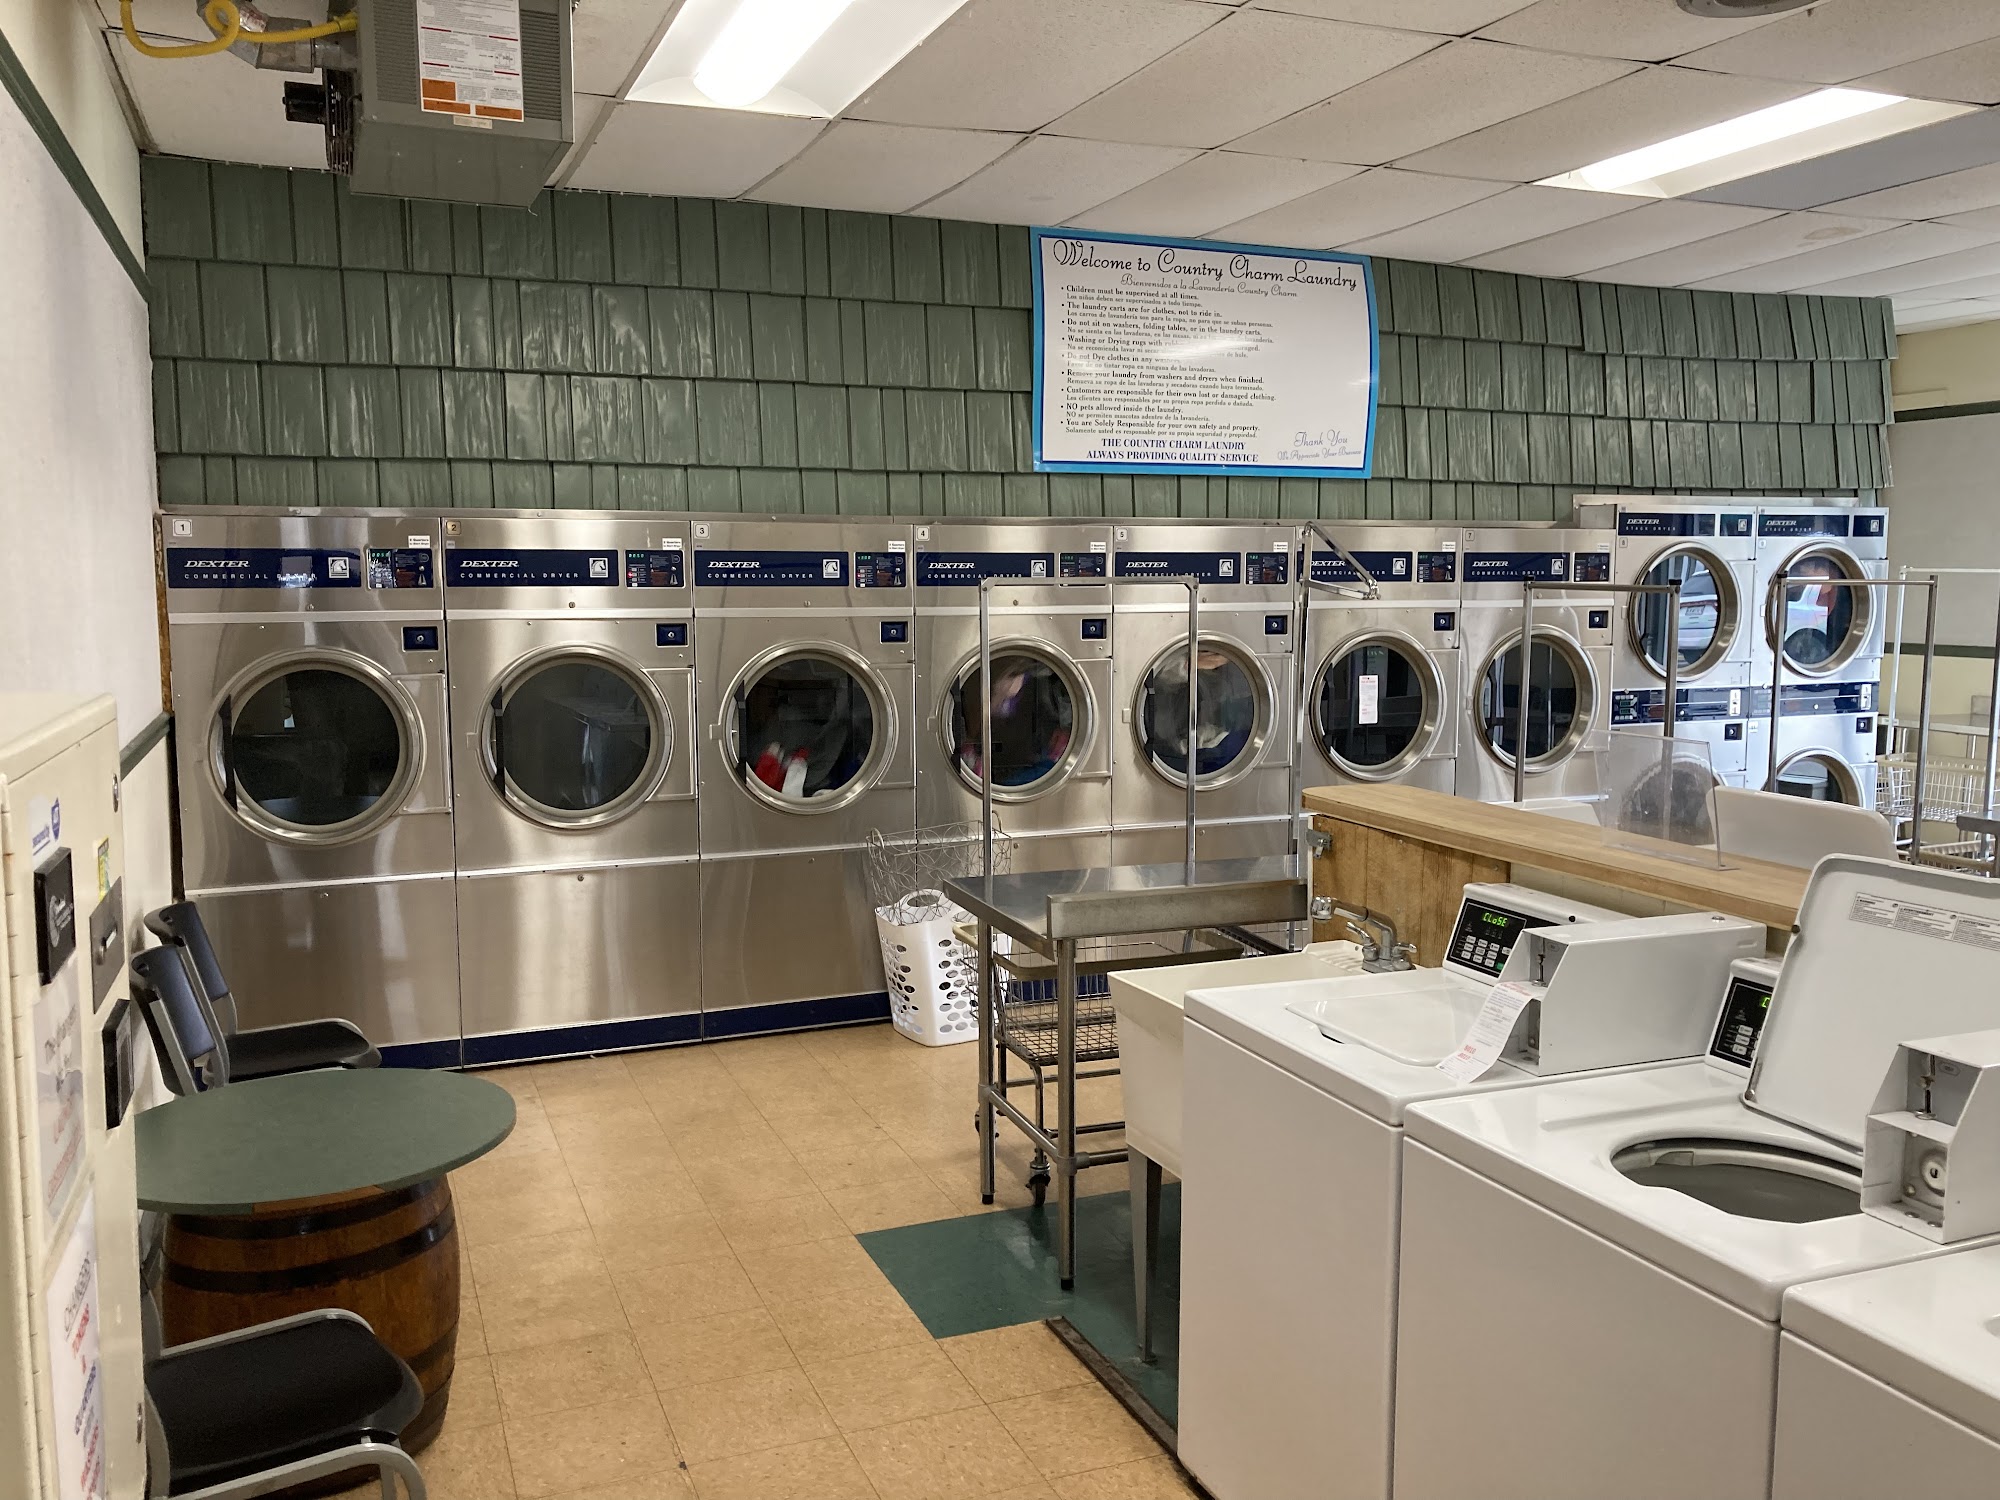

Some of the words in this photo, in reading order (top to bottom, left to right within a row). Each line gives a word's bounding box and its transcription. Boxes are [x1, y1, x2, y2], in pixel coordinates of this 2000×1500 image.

[1053, 240, 1132, 270] Welcome
[1138, 257, 1151, 272] to
[1158, 248, 1223, 281] Country
[1230, 254, 1284, 282] Charm
[1286, 260, 1357, 291] Laundry
[1066, 284, 1095, 293] Children
[1120, 273, 1171, 290] Bienvenidos
[1180, 279, 1187, 290] la
[1237, 282, 1269, 297] Country
[1271, 284, 1298, 298] Charm
[1082, 302, 1107, 311] laundry
[1152, 307, 1176, 315] clothes,
[1143, 322, 1165, 331] folding
[1220, 327, 1243, 335] laundry
[1068, 335, 1096, 344] Washing
[1108, 337, 1130, 345] Drying
[1092, 353, 1105, 361] Dye
[1112, 371, 1137, 379] laundry
[1157, 373, 1182, 382] washers
[1238, 376, 1264, 384] finished.
[1067, 386, 1101, 394] Customers
[1221, 392, 1248, 400] damaged
[1250, 393, 1276, 401] clothing.
[1096, 403, 1120, 411] allowed
[1157, 406, 1183, 414] laundry.
[1095, 419, 1114, 428] Solely
[1117, 420, 1155, 428] Responsible
[1294, 432, 1324, 447] Thank
[1327, 429, 1348, 446] You
[1101, 438, 1122, 447] THE
[1124, 439, 1167, 448] COUNTRY
[1169, 440, 1202, 449] CHARM
[1204, 441, 1246, 450] LAUNDRY
[1087, 451, 1125, 459] ALWAYS
[1127, 451, 1177, 461] PROVIDING
[1180, 452, 1218, 462] QUALITY
[1220, 454, 1258, 462] SERVICE
[180, 523, 185, 532] 1
[460, 560, 520, 568] DEXTER
